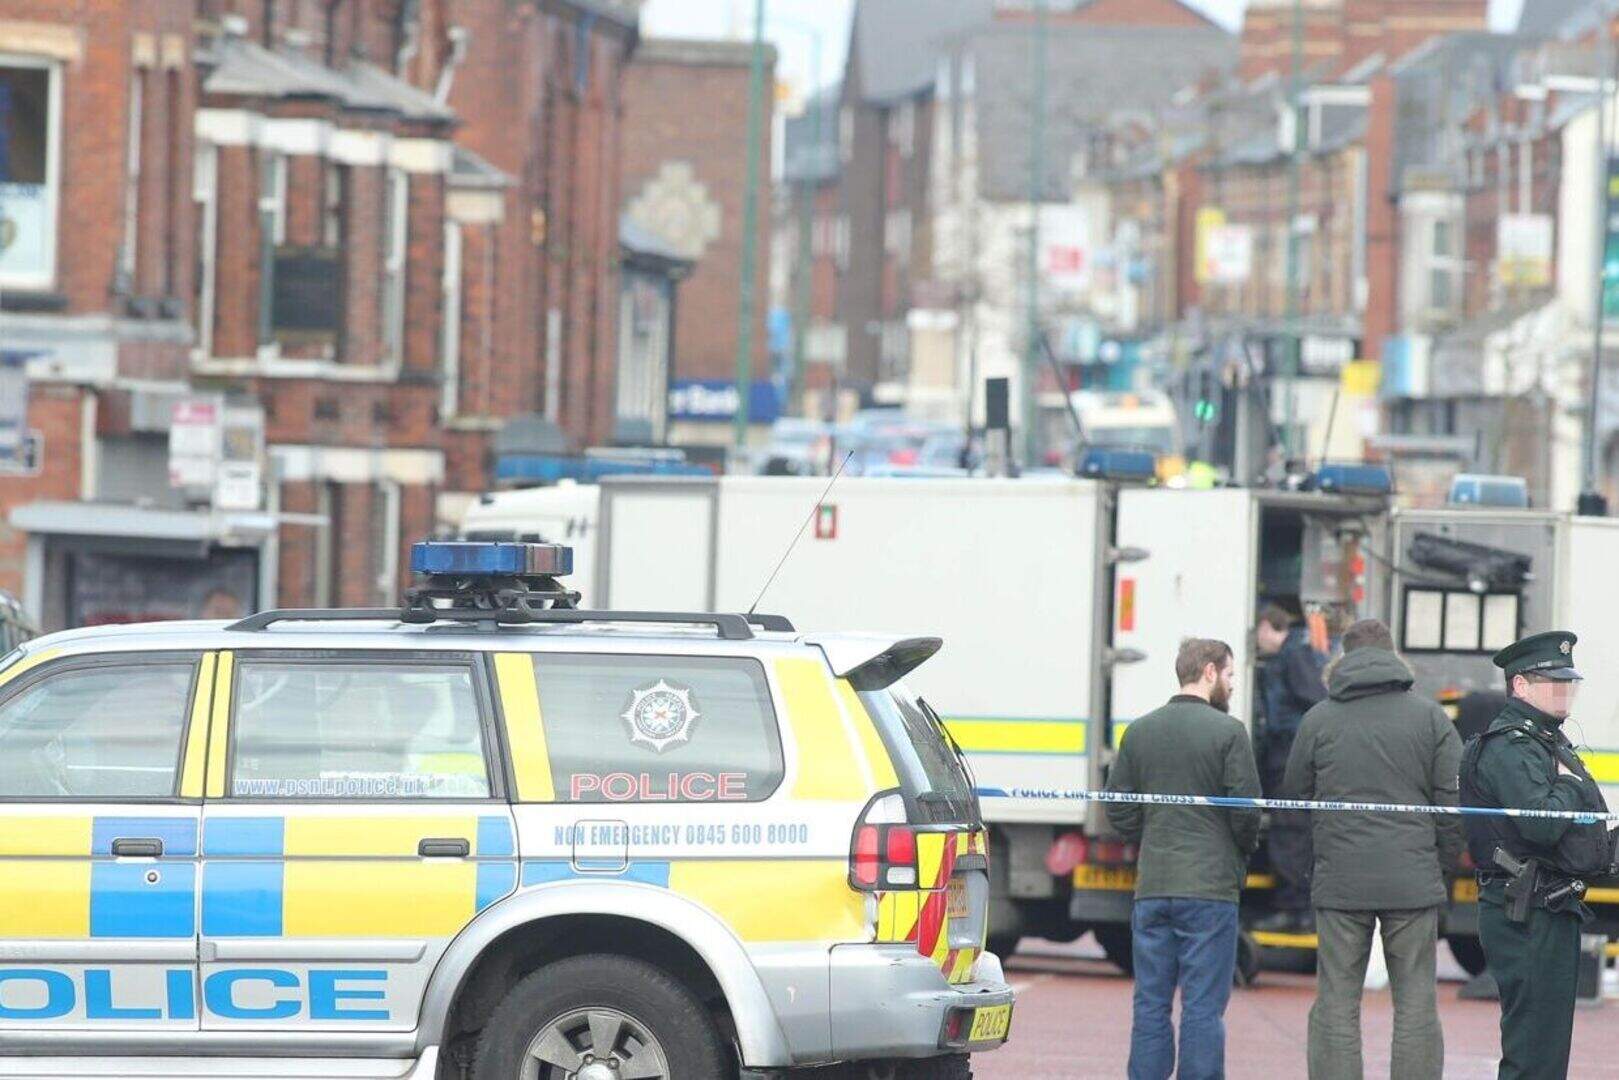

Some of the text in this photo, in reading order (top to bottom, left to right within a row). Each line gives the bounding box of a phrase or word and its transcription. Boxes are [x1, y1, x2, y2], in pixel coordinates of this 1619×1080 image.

[571, 772, 748, 801] POLICE
[1012, 788, 1059, 799] POLICE
[1064, 790, 1093, 800] LINE
[554, 823, 808, 846] NON EMERGENCY 0845 600 8000
[0, 969, 390, 1020] OLICE
